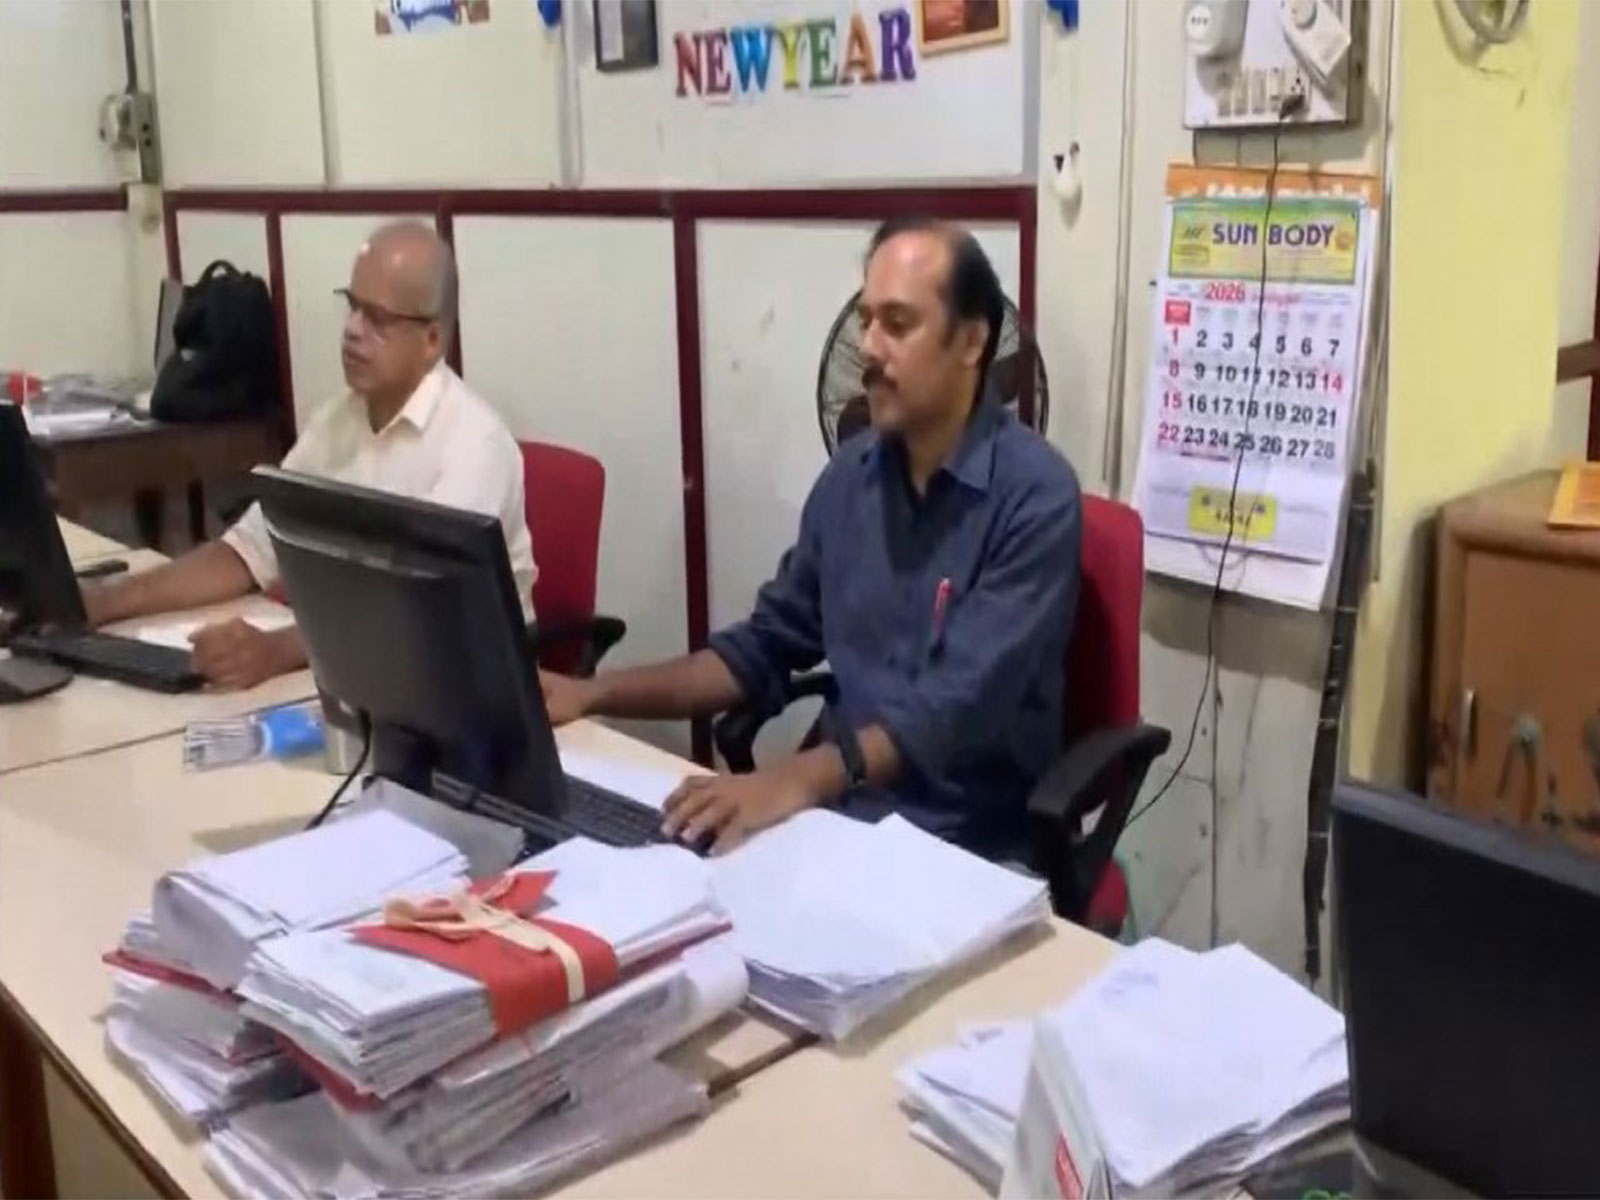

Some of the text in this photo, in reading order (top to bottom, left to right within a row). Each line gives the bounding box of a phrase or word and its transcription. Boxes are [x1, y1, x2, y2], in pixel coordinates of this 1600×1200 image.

[1212, 223, 1258, 246] SUN
[1268, 225, 1335, 247] BODY
[1204, 282, 1246, 302] 2026
[1171, 329, 1340, 356] 1 2 3 4 5 6 7
[1168, 360, 1343, 393] 8 9 10 11 12 13 14
[1163, 392, 1337, 428] 15 16 17 18 19 20 21
[1158, 423, 1335, 460] 22 23 24 25 26 27 28
